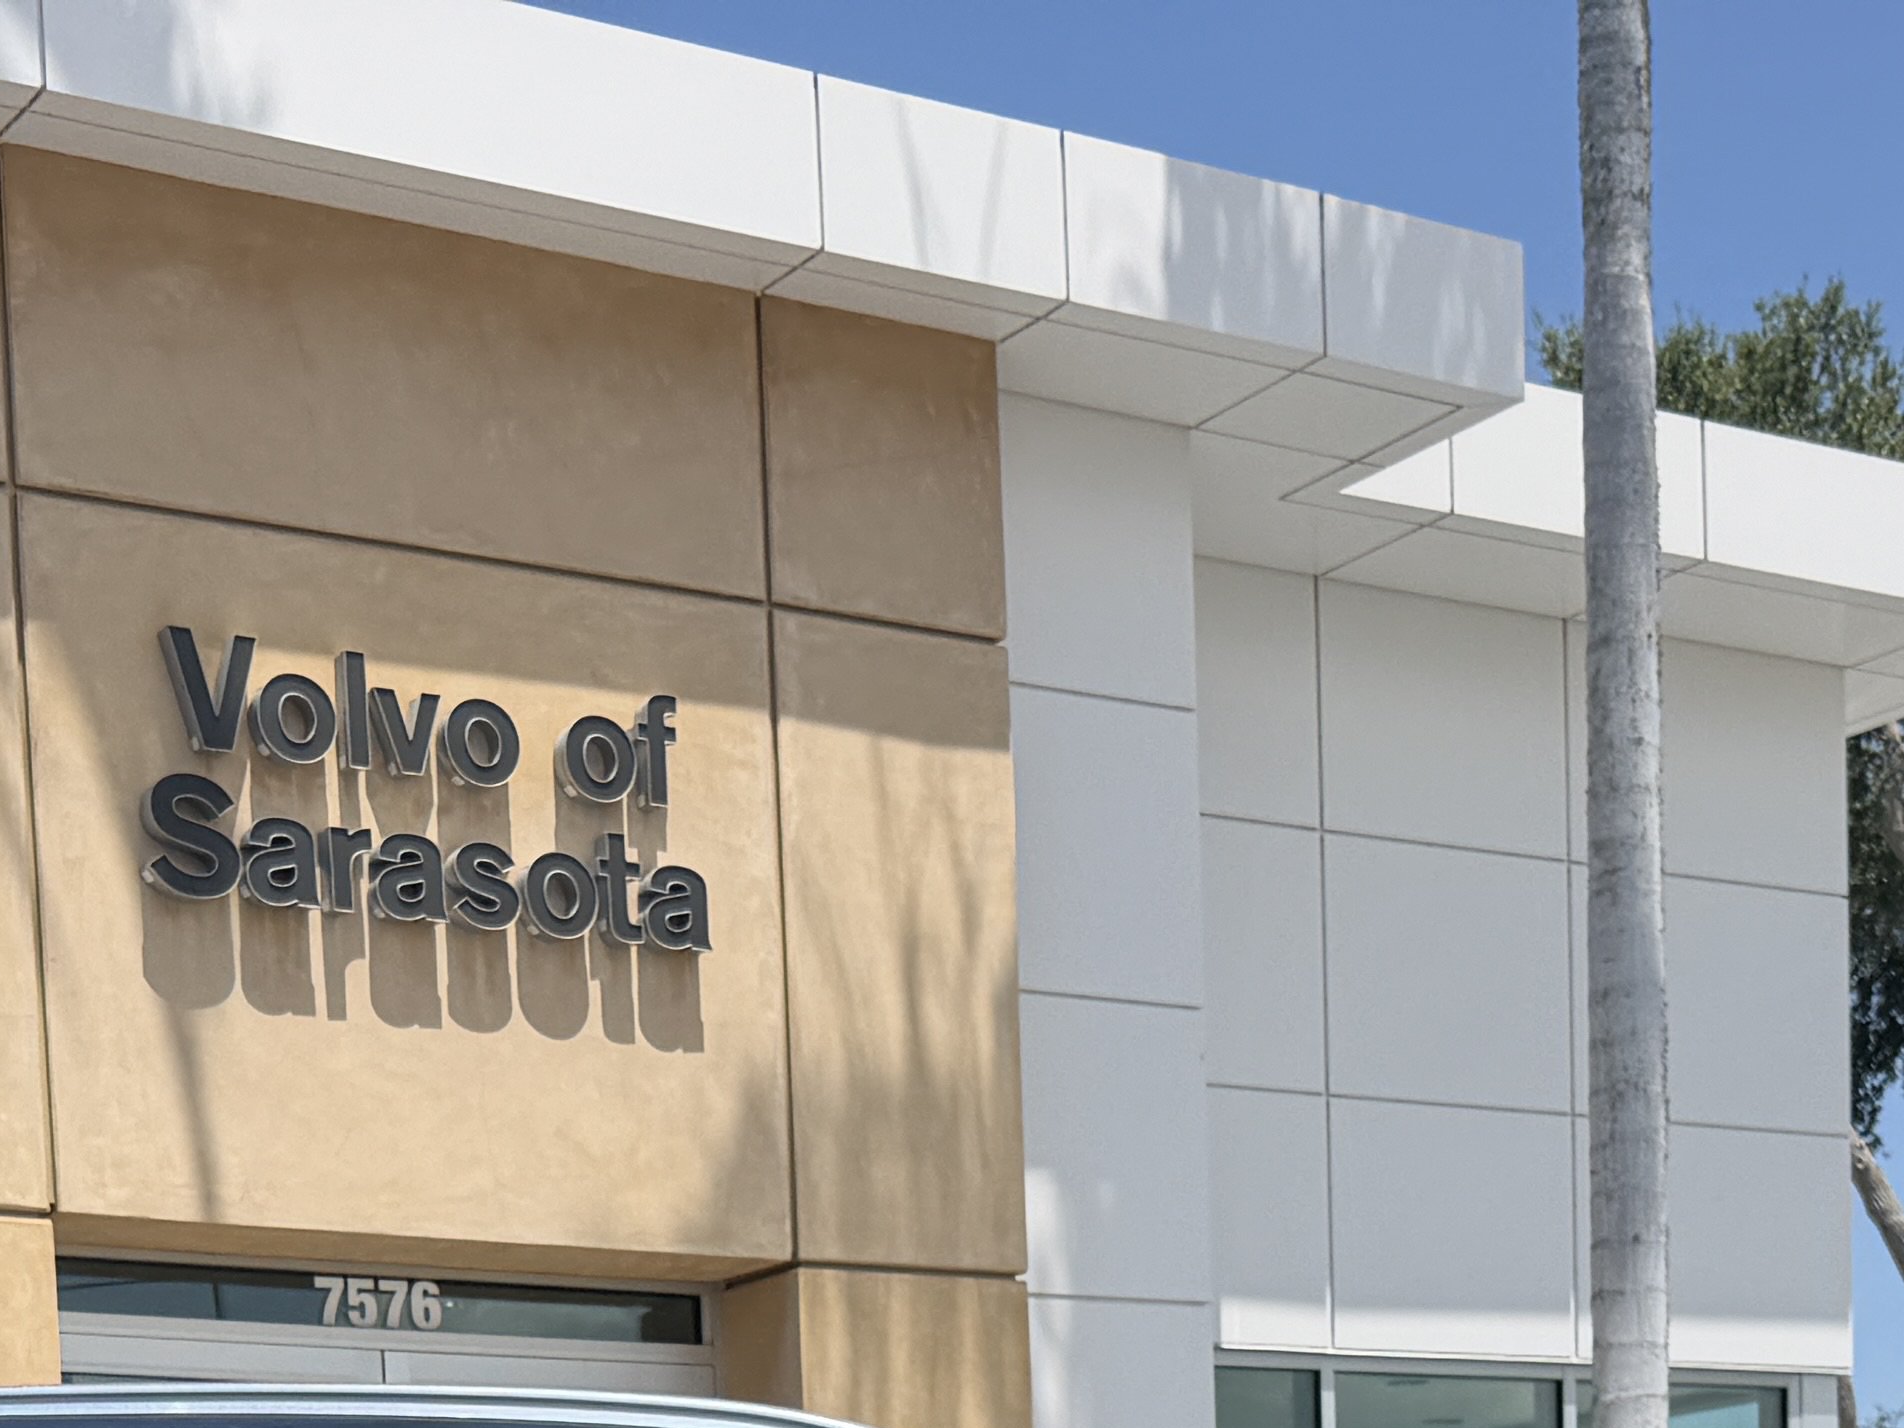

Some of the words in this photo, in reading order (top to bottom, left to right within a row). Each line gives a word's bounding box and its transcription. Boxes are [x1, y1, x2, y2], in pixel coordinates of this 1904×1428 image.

[158, 625, 520, 788] Volvo
[554, 694, 677, 808] of
[140, 773, 713, 953] Sarasota
[313, 1275, 443, 1331] 7576
